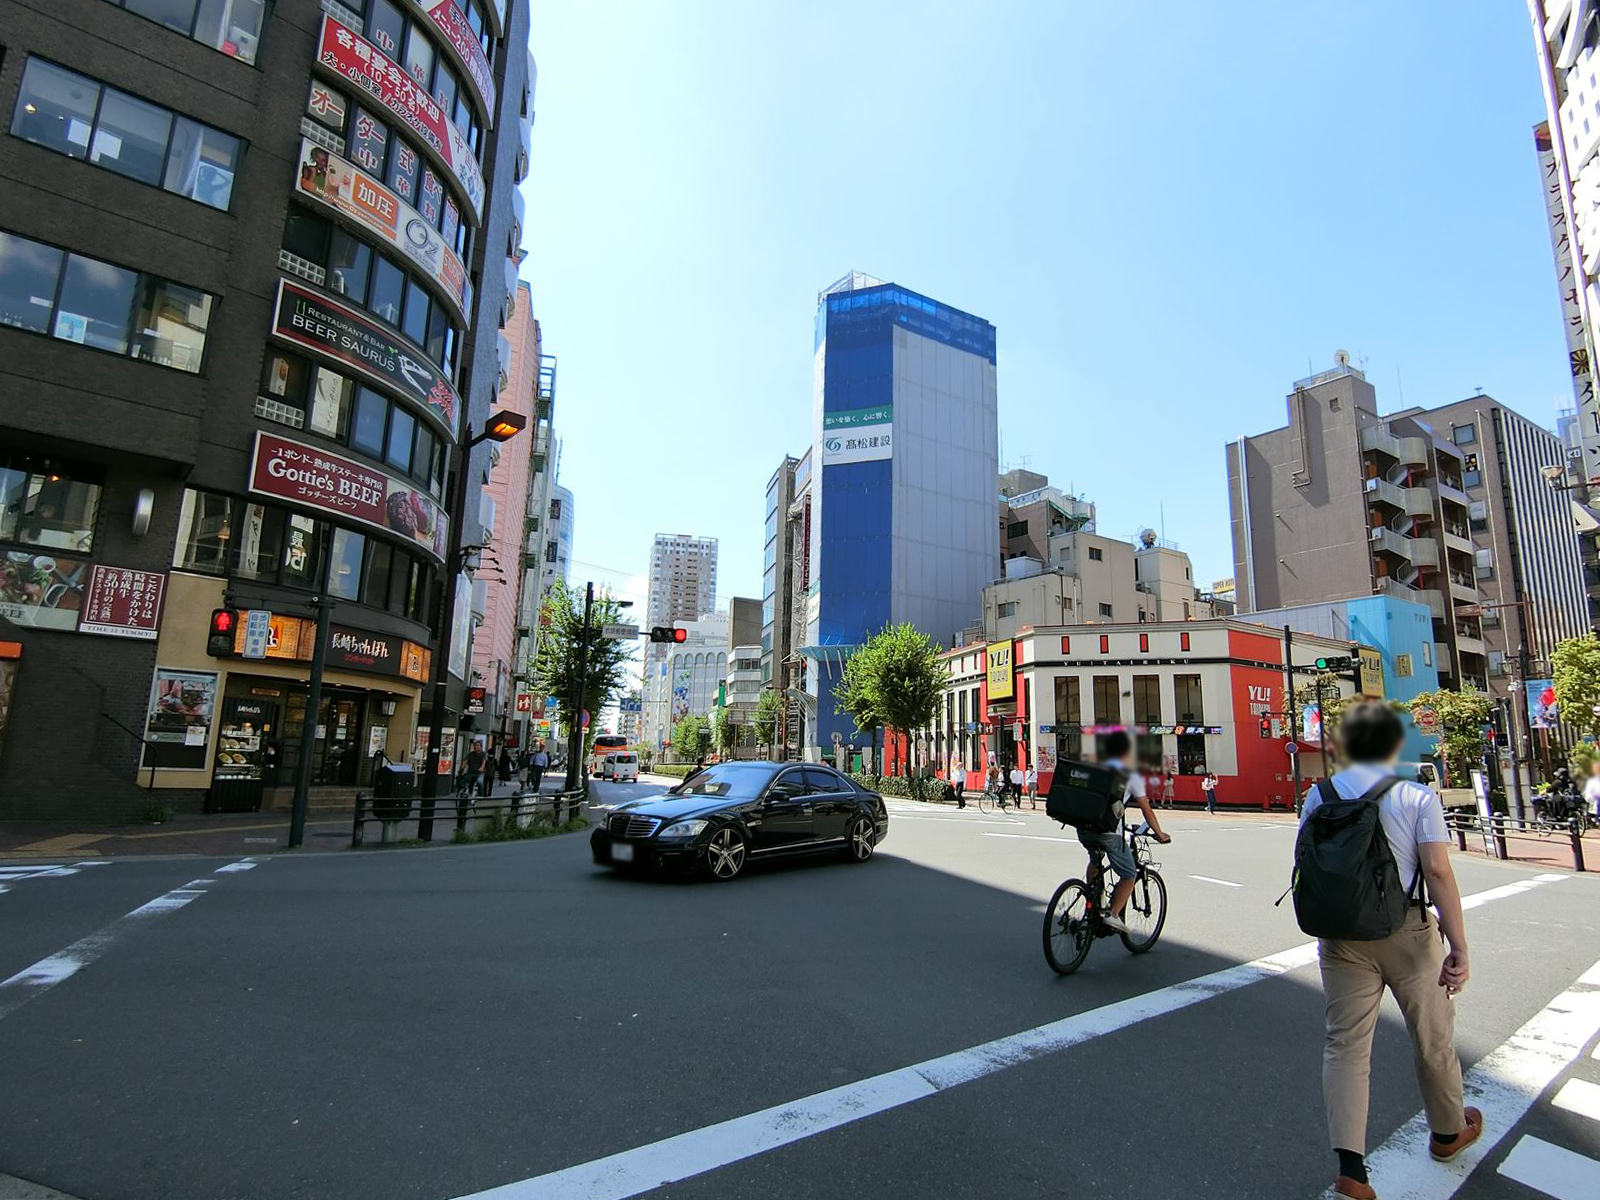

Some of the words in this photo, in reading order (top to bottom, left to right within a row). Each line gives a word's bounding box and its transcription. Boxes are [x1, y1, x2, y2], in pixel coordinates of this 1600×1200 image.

[357, 182, 396, 222] 加圧
[292, 313, 338, 343] BEER
[340, 335, 396, 373] SAURUS
[268, 457, 335, 493] Gottie's
[337, 477, 382, 508] BEEF
[127, 573, 146, 626] 時間をかけた
[142, 574, 158, 619] こだわりは
[332, 632, 390, 658] 長崎ちゃんぽん
[1247, 685, 1271, 702] YU!
